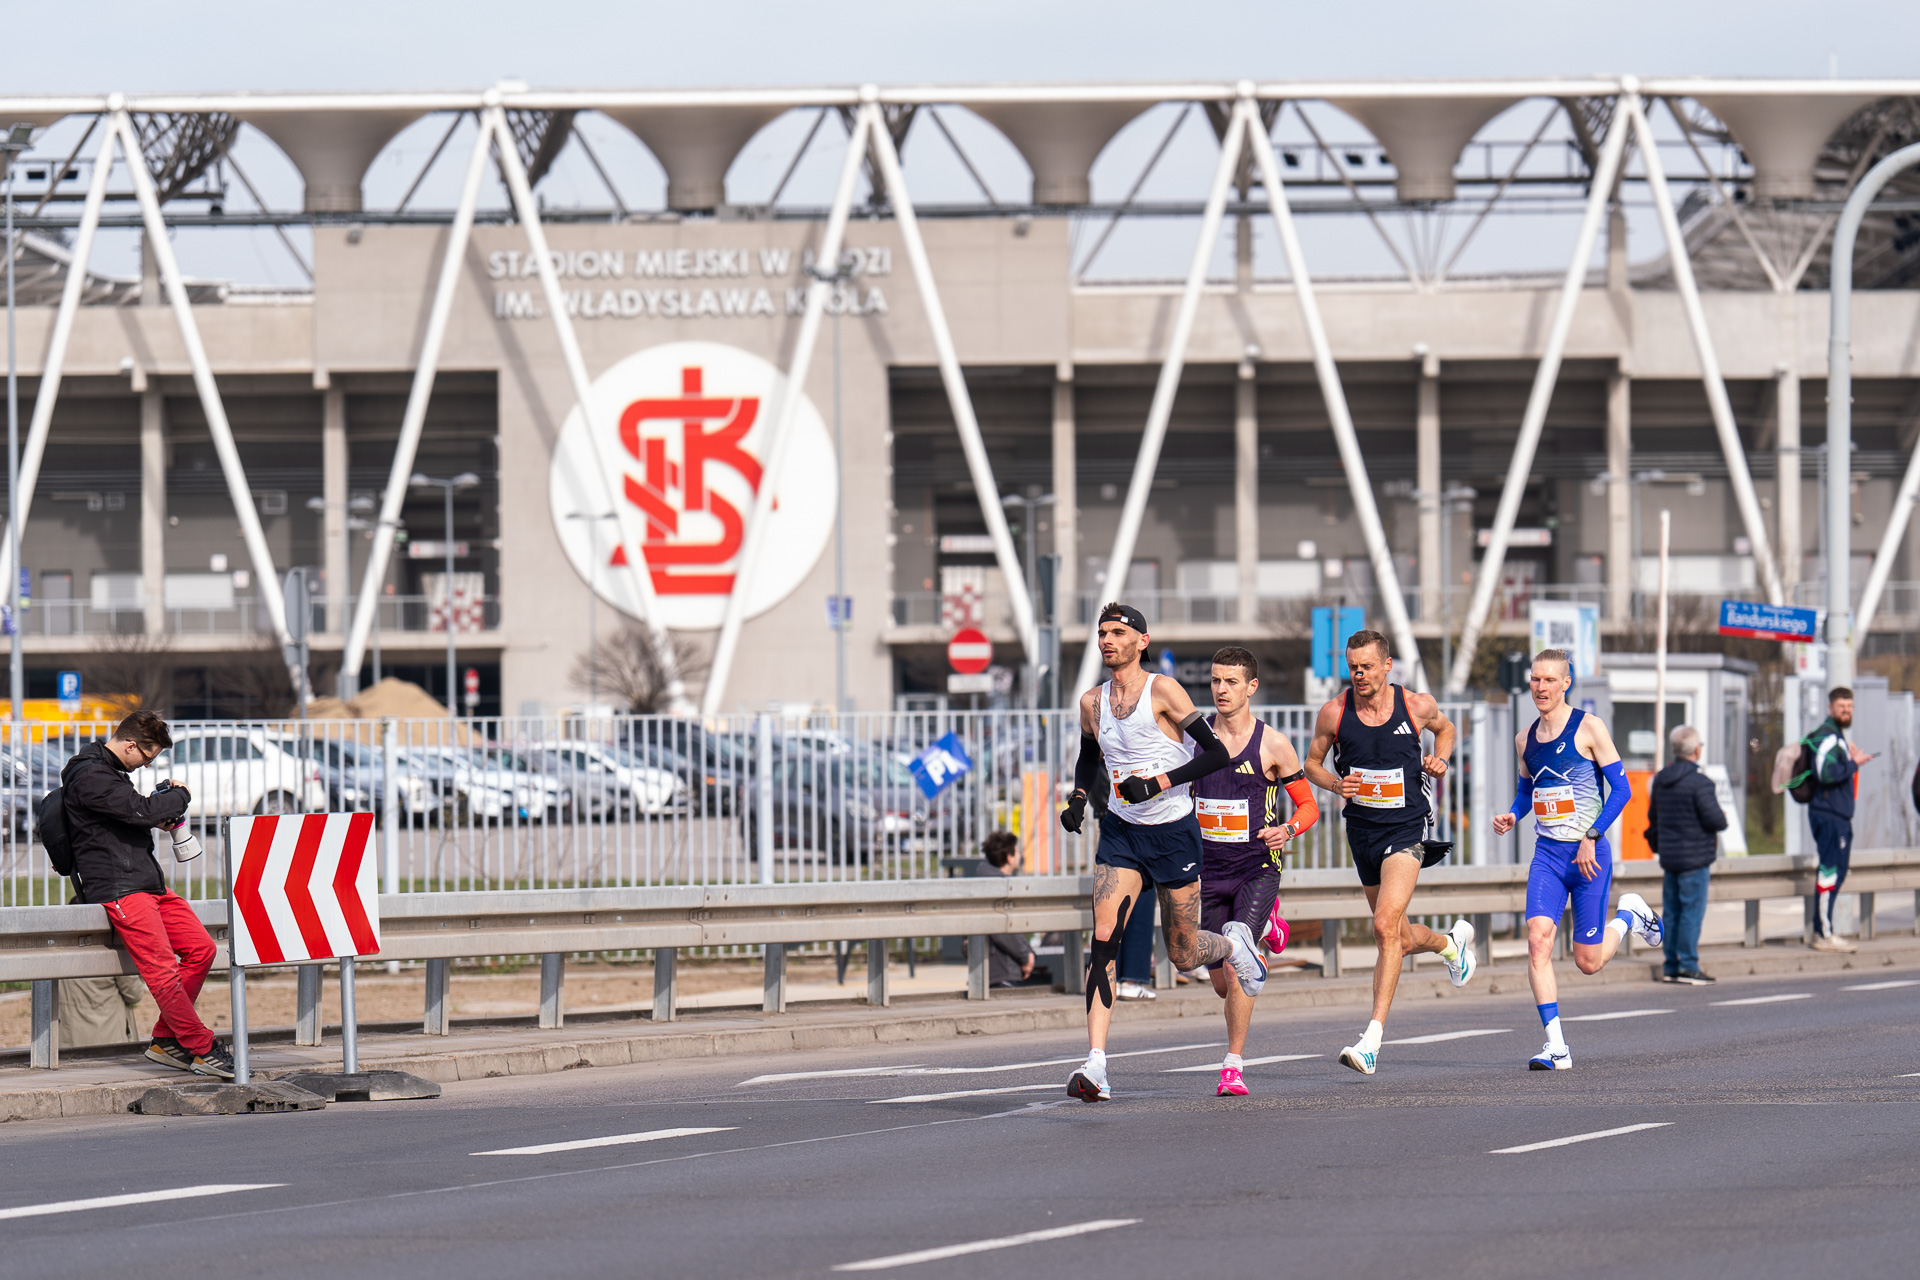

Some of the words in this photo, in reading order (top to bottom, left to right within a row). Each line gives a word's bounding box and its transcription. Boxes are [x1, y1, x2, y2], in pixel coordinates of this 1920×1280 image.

[488, 250, 624, 279] STADION
[634, 249, 749, 277] MIEJSKI
[758, 248, 790, 275] W
[803, 246, 890, 273] DZI
[495, 289, 543, 318] IM.
[785, 280, 889, 314] KÓLA
[1726, 608, 1808, 635] Bandurskiego
[1372, 783, 1382, 795] 4
[1544, 801, 1558, 812] 10
[1216, 814, 1223, 827] 1
